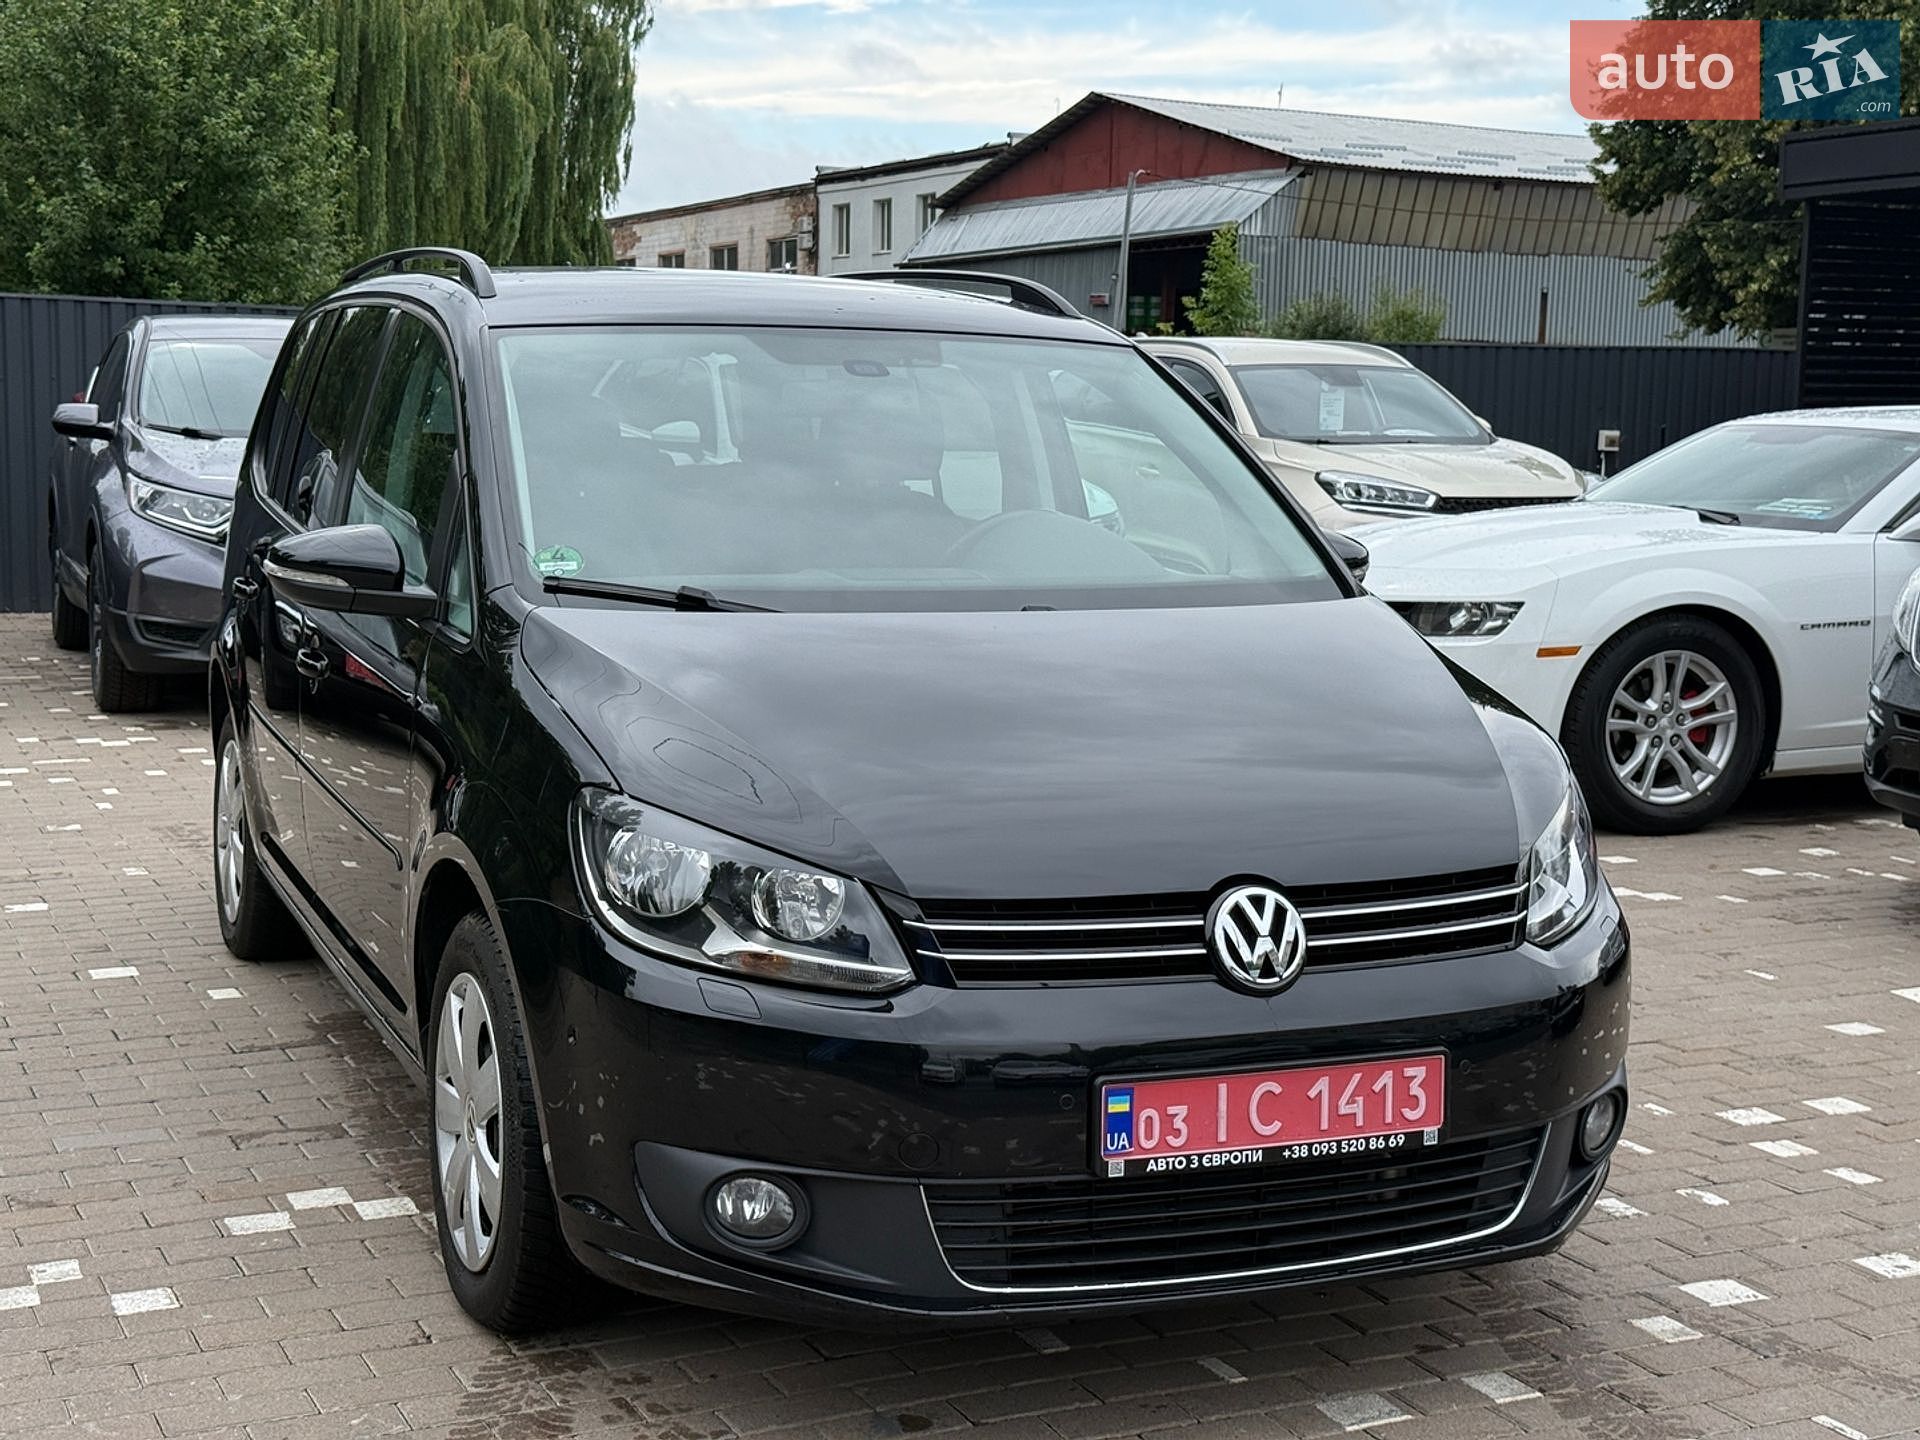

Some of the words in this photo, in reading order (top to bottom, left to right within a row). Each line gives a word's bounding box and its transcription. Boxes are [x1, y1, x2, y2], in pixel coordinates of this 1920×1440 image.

[1800, 620, 1871, 630] CAMARO
[1214, 886, 1306, 984] VW
[1137, 1105, 1190, 1149] 03
[1307, 1066, 1428, 1131] 1413
[1106, 1132, 1130, 1151] UA
[1282, 1144, 1309, 1159] +38
[1311, 1142, 1338, 1156] 093
[1341, 1138, 1366, 1152] 520
[1369, 1136, 1386, 1149] 86
[1388, 1134, 1406, 1147] 69
[1146, 1156, 1187, 1173] АВТО
[1202, 1150, 1263, 1167] ЄВРОПИ
